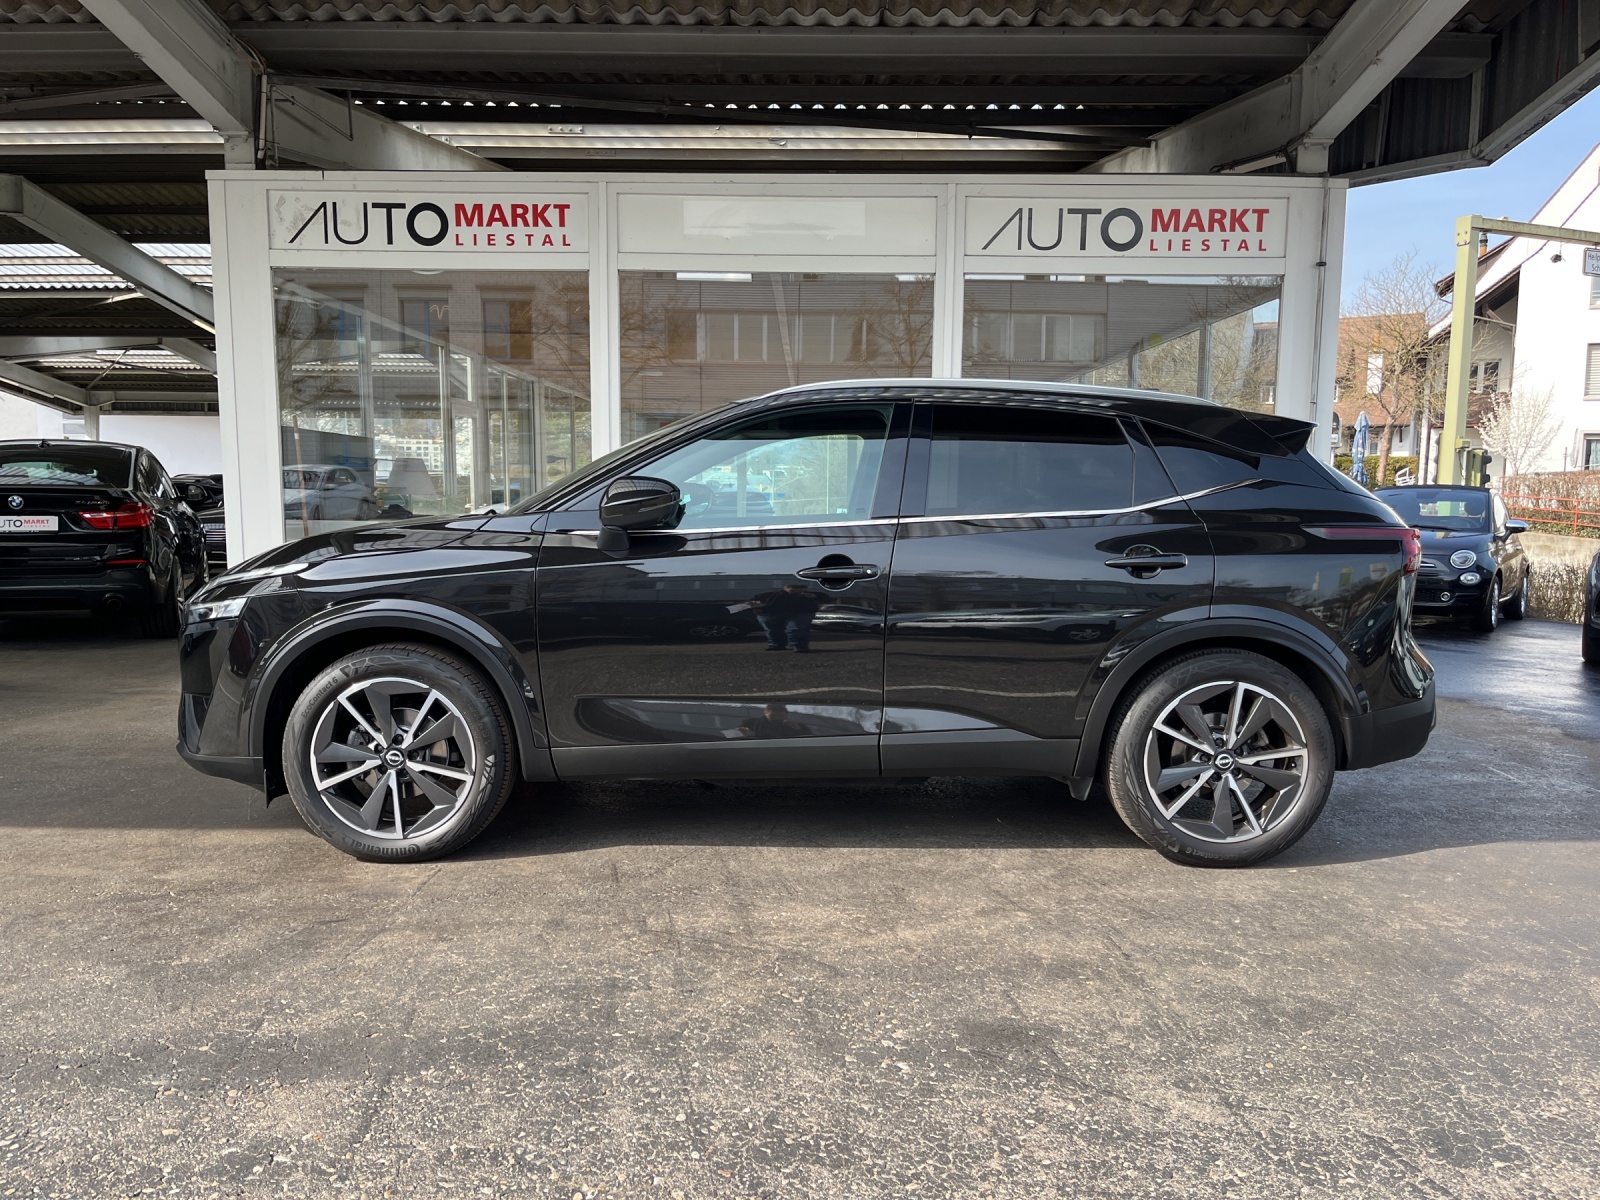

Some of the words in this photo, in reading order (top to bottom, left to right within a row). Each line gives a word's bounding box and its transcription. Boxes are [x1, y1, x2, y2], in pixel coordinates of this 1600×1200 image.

[288, 202, 449, 247] AUTO
[454, 203, 571, 228] MARKT
[455, 233, 571, 246] LIESTAL
[981, 207, 1143, 252] AUTO
[1150, 208, 1269, 233] MARKT
[1149, 239, 1267, 252] LIESTAL
[301, 681, 334, 719] EcoContact
[332, 676, 339, 685] 6
[351, 839, 421, 857] Continental
